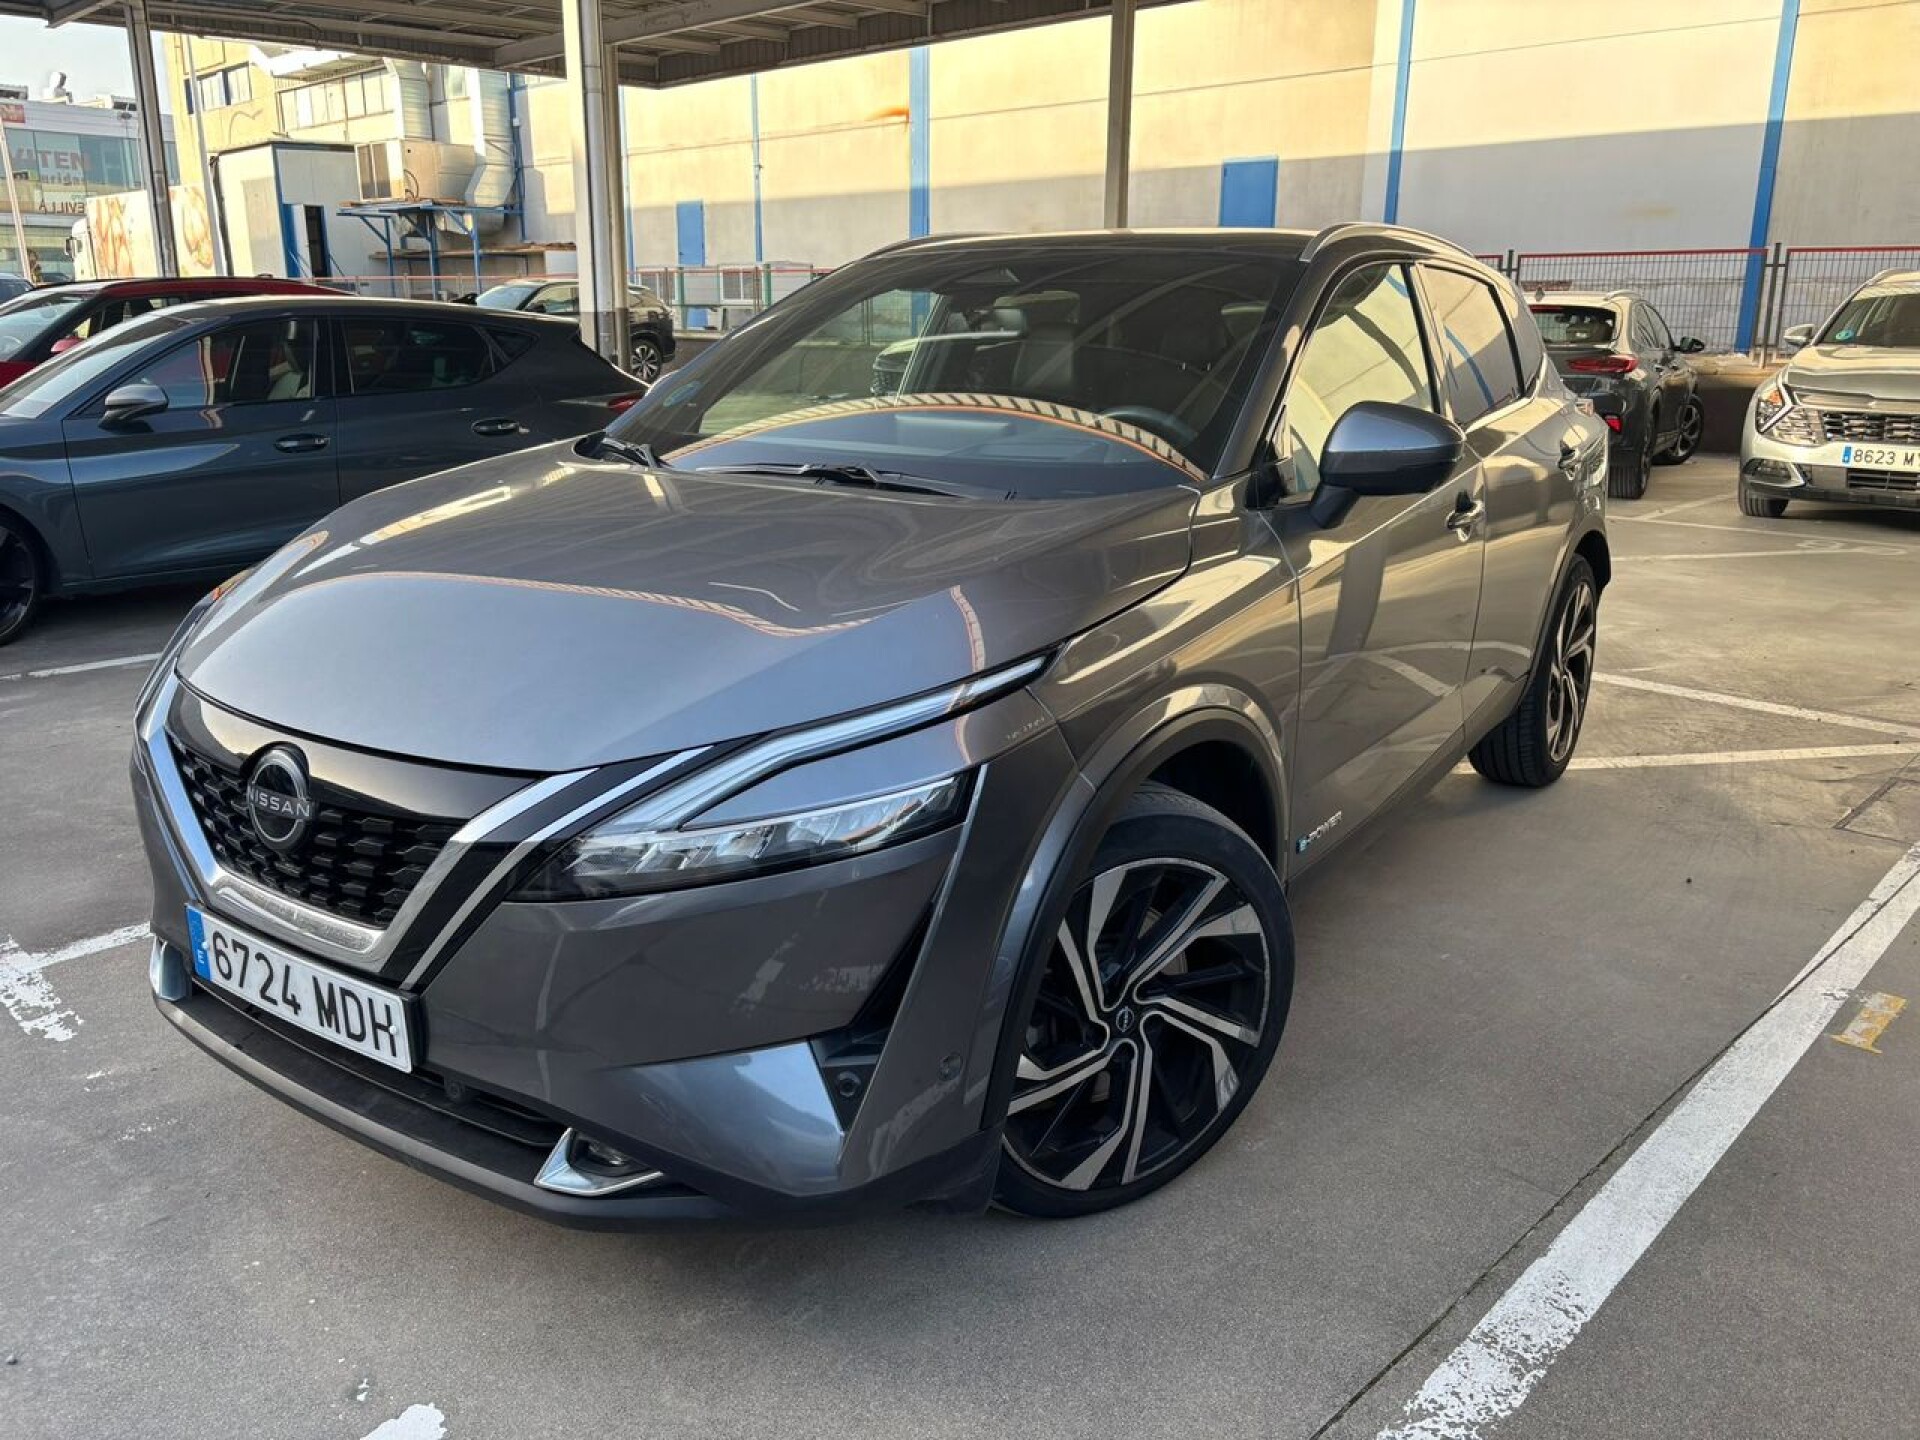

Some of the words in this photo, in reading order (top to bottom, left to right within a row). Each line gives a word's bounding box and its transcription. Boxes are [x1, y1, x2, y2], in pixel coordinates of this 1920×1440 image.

[1853, 449, 1897, 466] 8623
[1902, 452, 1920, 467] M
[246, 785, 310, 817] NISSAN
[212, 930, 302, 1016] 6724
[311, 974, 398, 1058] MDH
